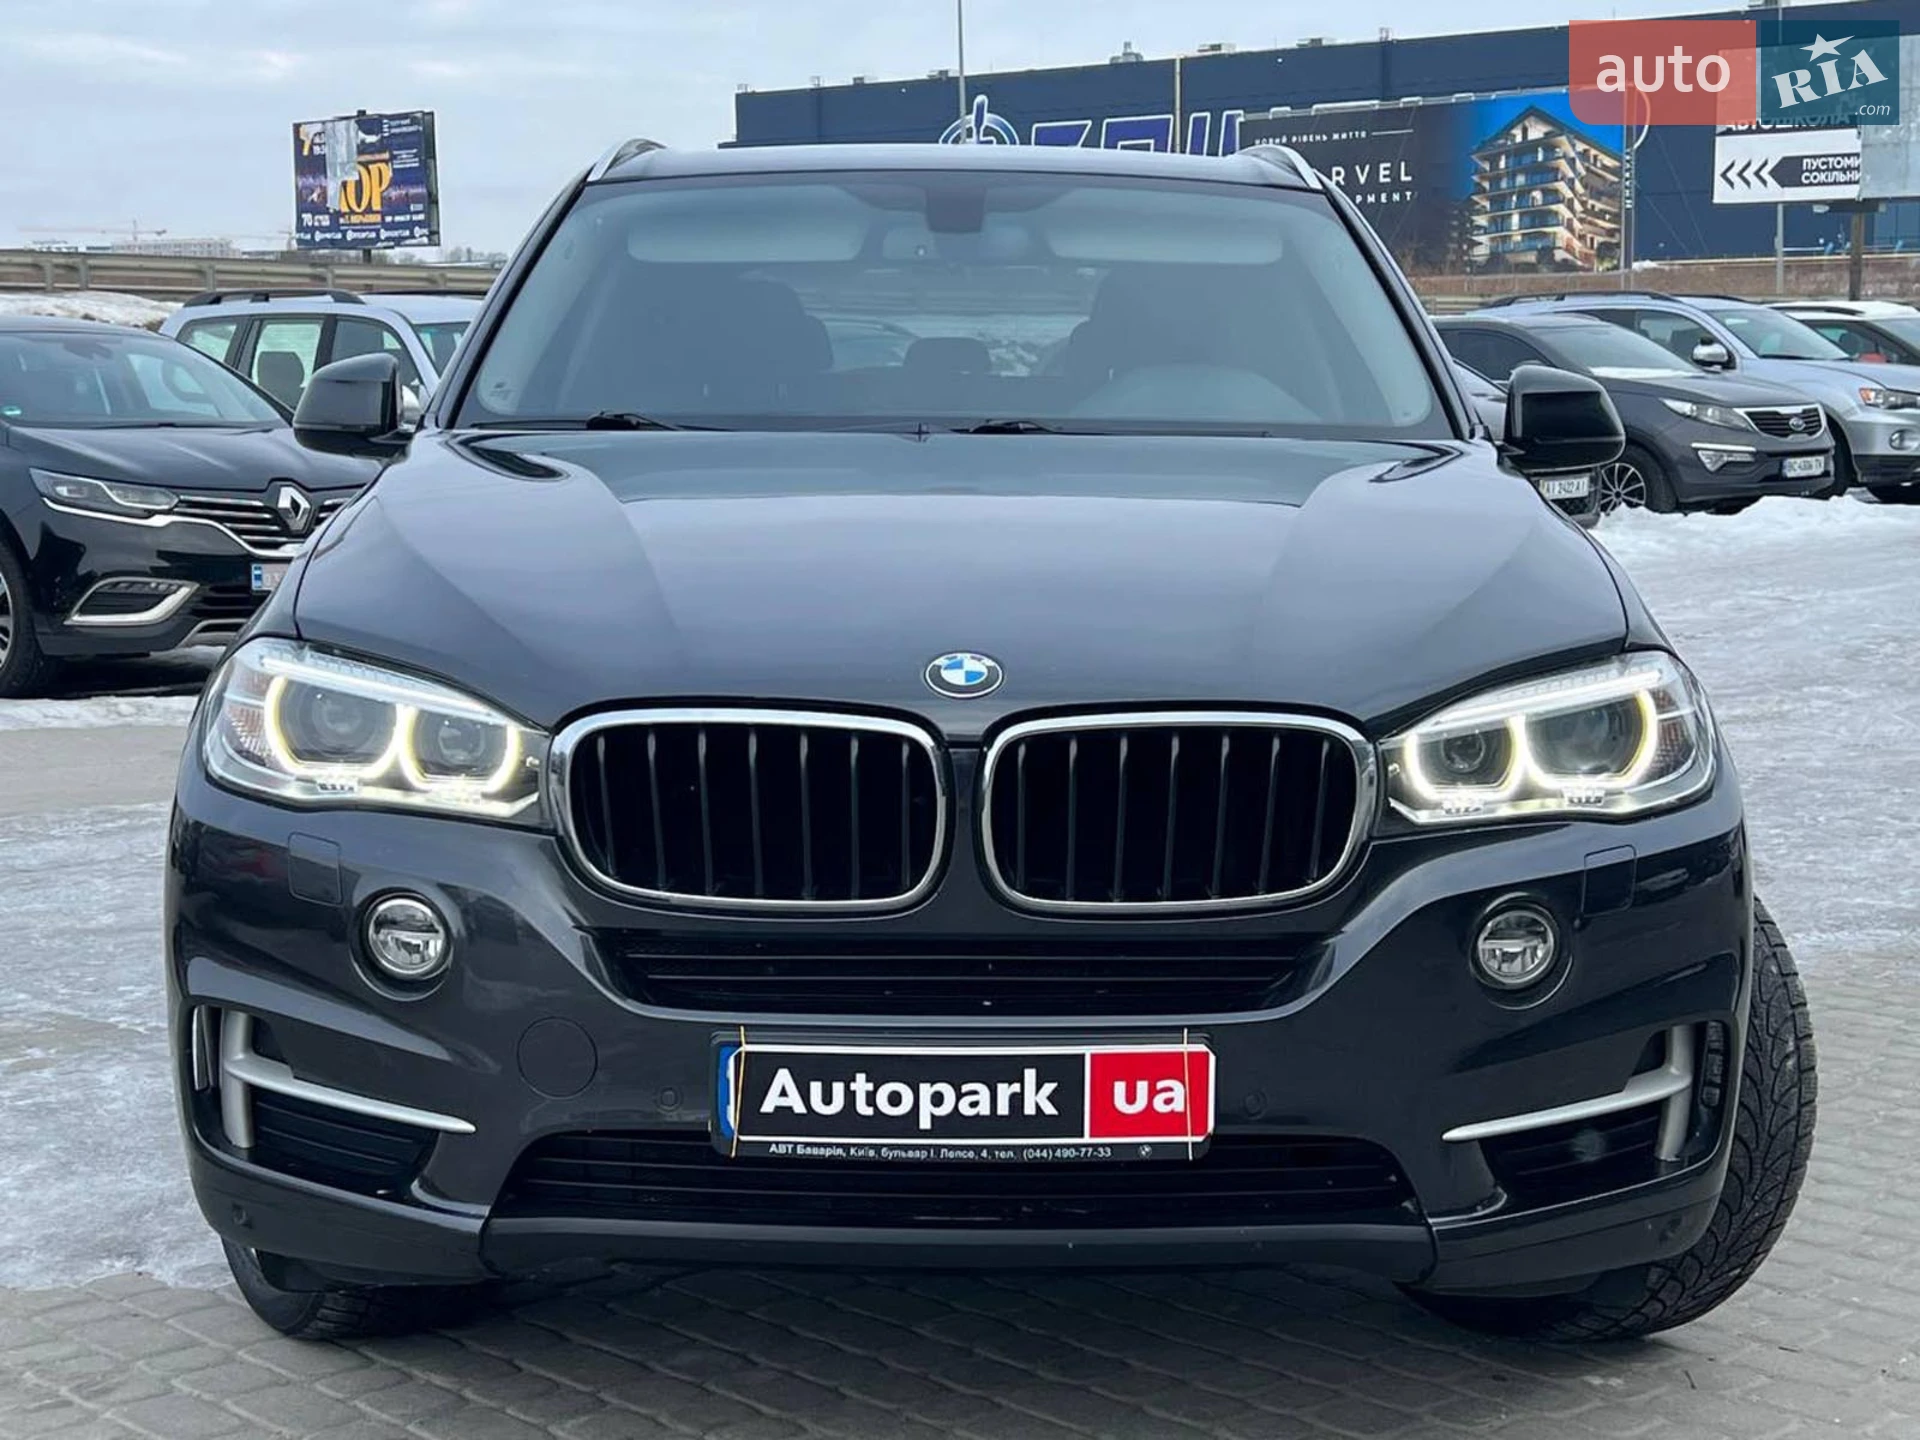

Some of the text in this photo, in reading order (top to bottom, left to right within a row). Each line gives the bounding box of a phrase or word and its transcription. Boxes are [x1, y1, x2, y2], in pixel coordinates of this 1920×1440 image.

[1331, 161, 1413, 185] RVEL
[1355, 191, 1413, 204] PMENT
[760, 1067, 1187, 1130] Autopark ua
[1023, 1148, 1053, 1161] (044)
[1055, 1147, 1112, 1158] 490-77-33
